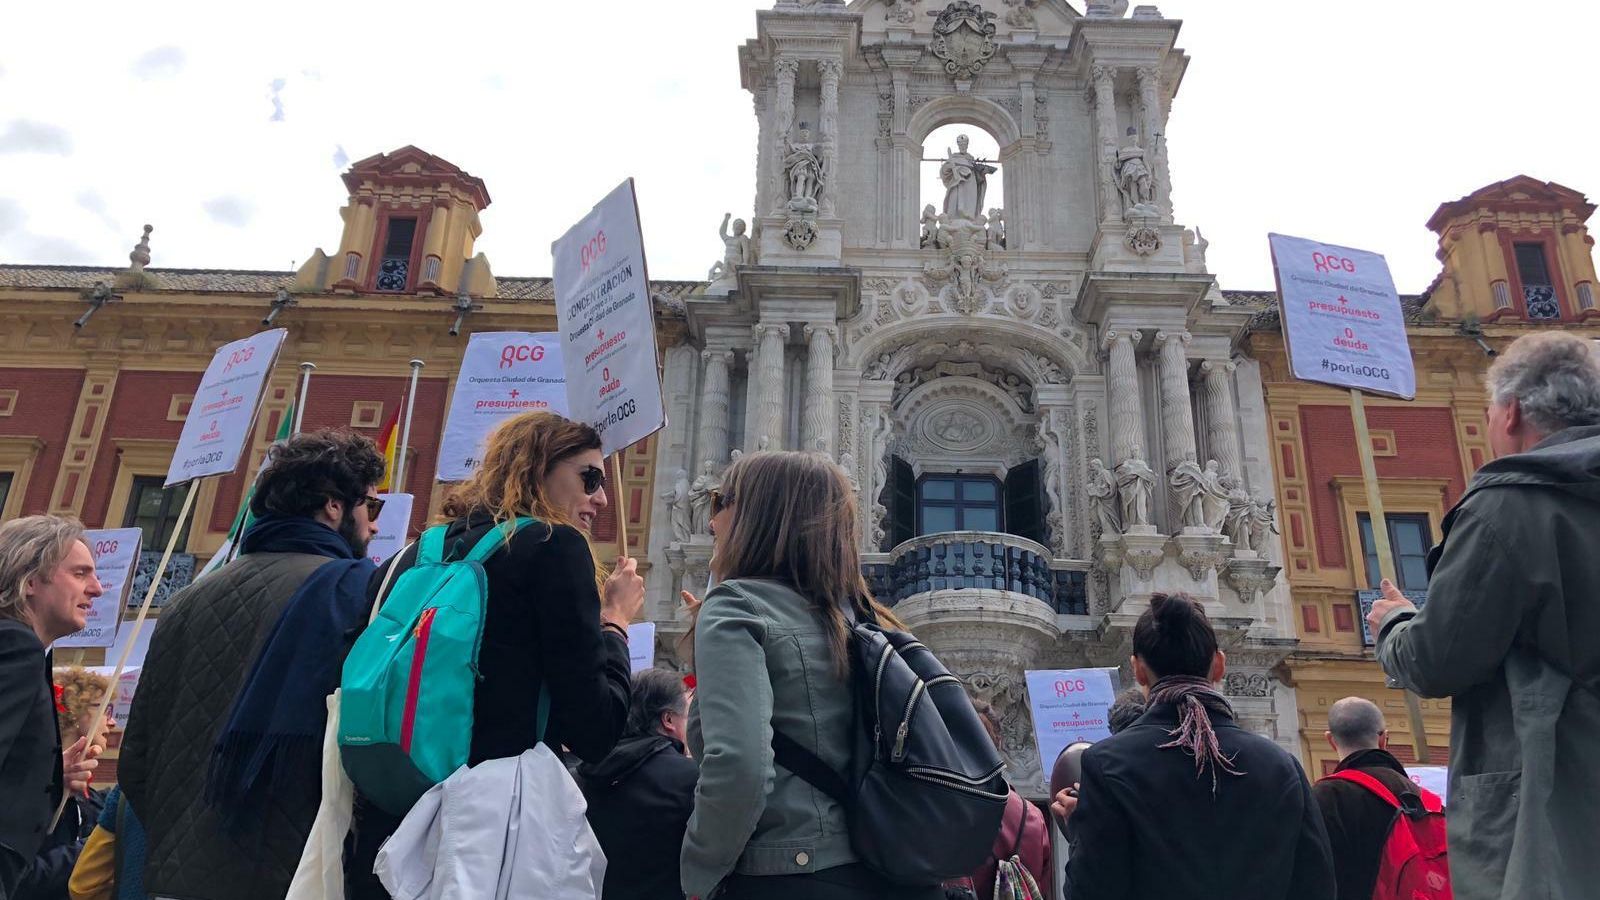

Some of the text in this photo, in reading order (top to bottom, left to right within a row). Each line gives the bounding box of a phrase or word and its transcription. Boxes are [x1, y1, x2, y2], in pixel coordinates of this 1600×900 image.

[567, 265, 633, 321] CONCENTRACIÓN
[588, 309, 606, 327] Cidad
[613, 292, 636, 311] Granada
[1309, 301, 1380, 320] presupuesto
[1344, 327, 1353, 339] 0
[585, 330, 626, 367] presupuesto
[1333, 336, 1369, 351] deuda
[602, 367, 610, 382] 0
[1321, 358, 1390, 380] #porlaOCG
[469, 376, 501, 384] Orquesta
[476, 400, 548, 409] presupuesto
[70, 628, 102, 639] porlaOCG
[1053, 719, 1103, 728] presupuesto
